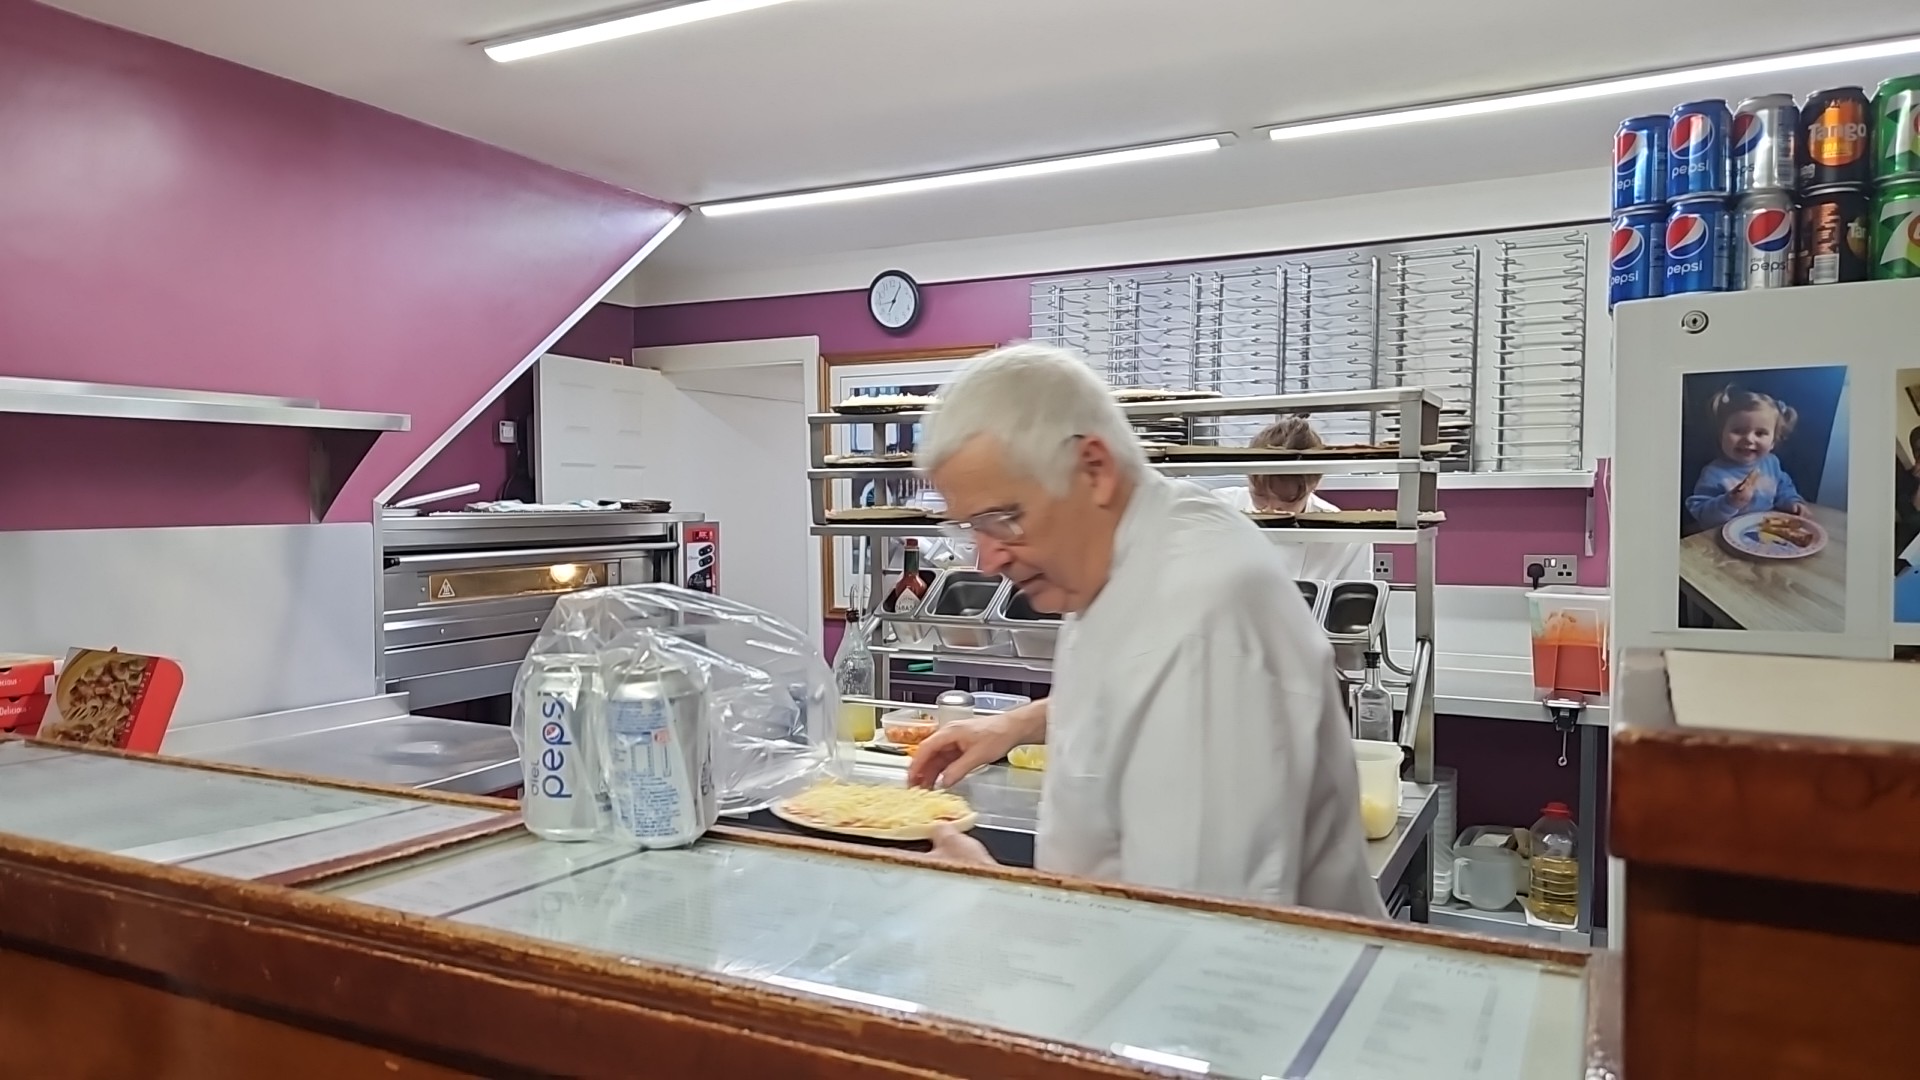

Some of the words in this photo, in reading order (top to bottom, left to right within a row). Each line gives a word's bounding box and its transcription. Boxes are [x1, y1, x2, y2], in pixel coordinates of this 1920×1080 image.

[1808, 122, 1867, 142] Tango
[1671, 160, 1709, 180] pepsi
[1667, 260, 1703, 278] pepsi
[1750, 261, 1787, 275] peps
[537, 691, 573, 799] pepsi
